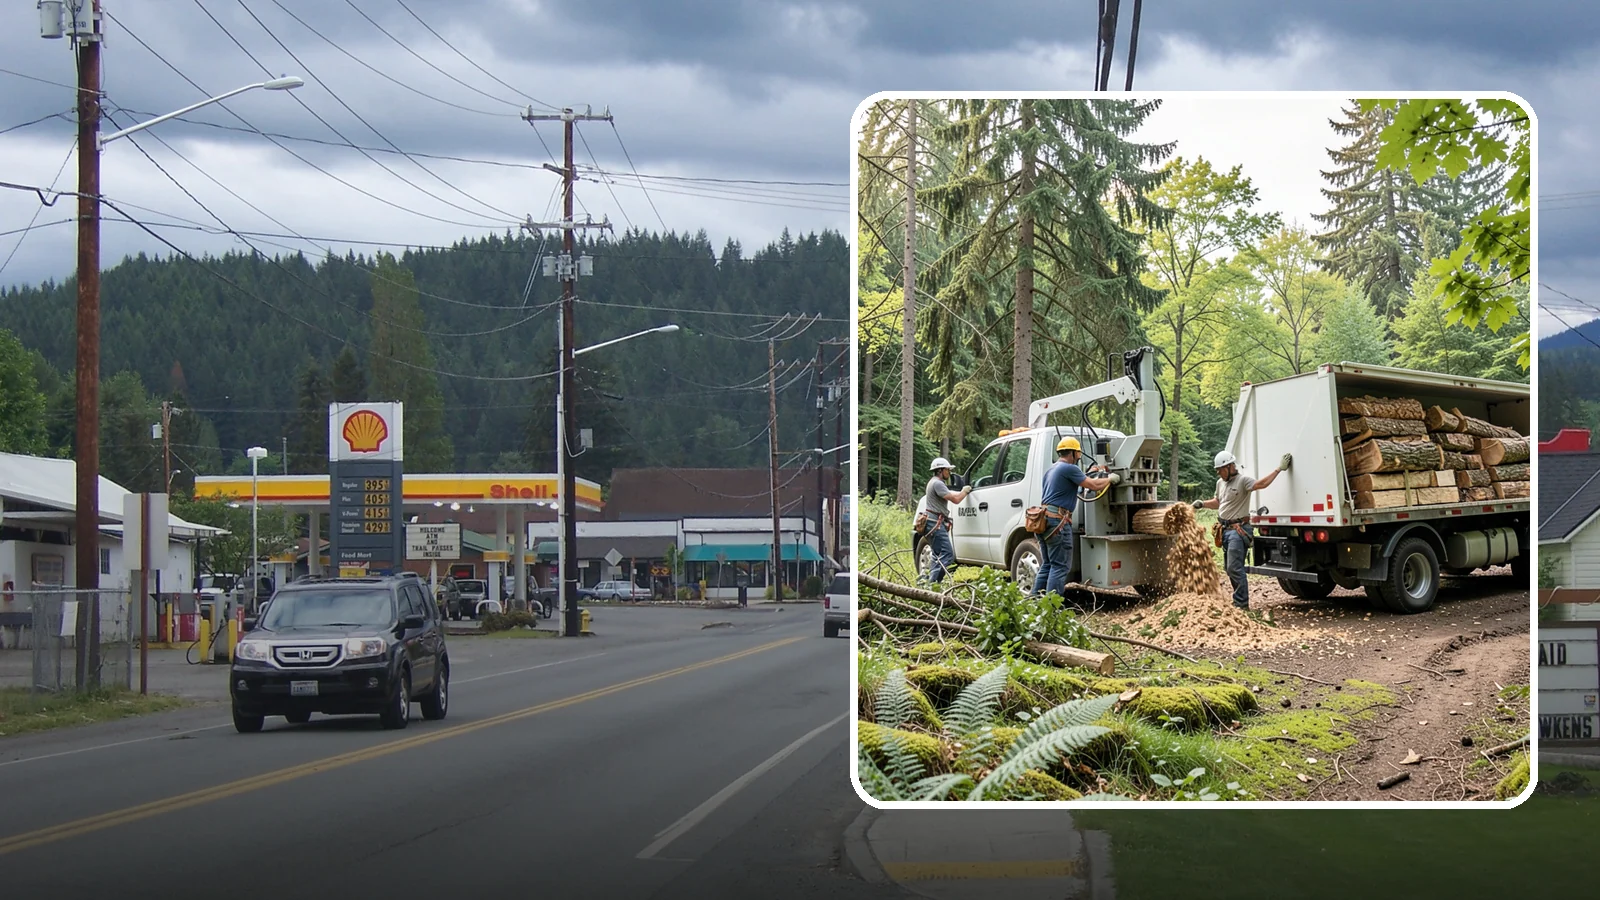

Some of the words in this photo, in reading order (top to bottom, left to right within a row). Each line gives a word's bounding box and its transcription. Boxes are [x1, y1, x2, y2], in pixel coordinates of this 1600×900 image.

[366, 480, 383, 490] 395
[490, 484, 547, 499] Shell
[366, 494, 383, 504] 405
[366, 508, 383, 518] 415
[366, 522, 383, 532] 429
[1538, 642, 1567, 665] AID
